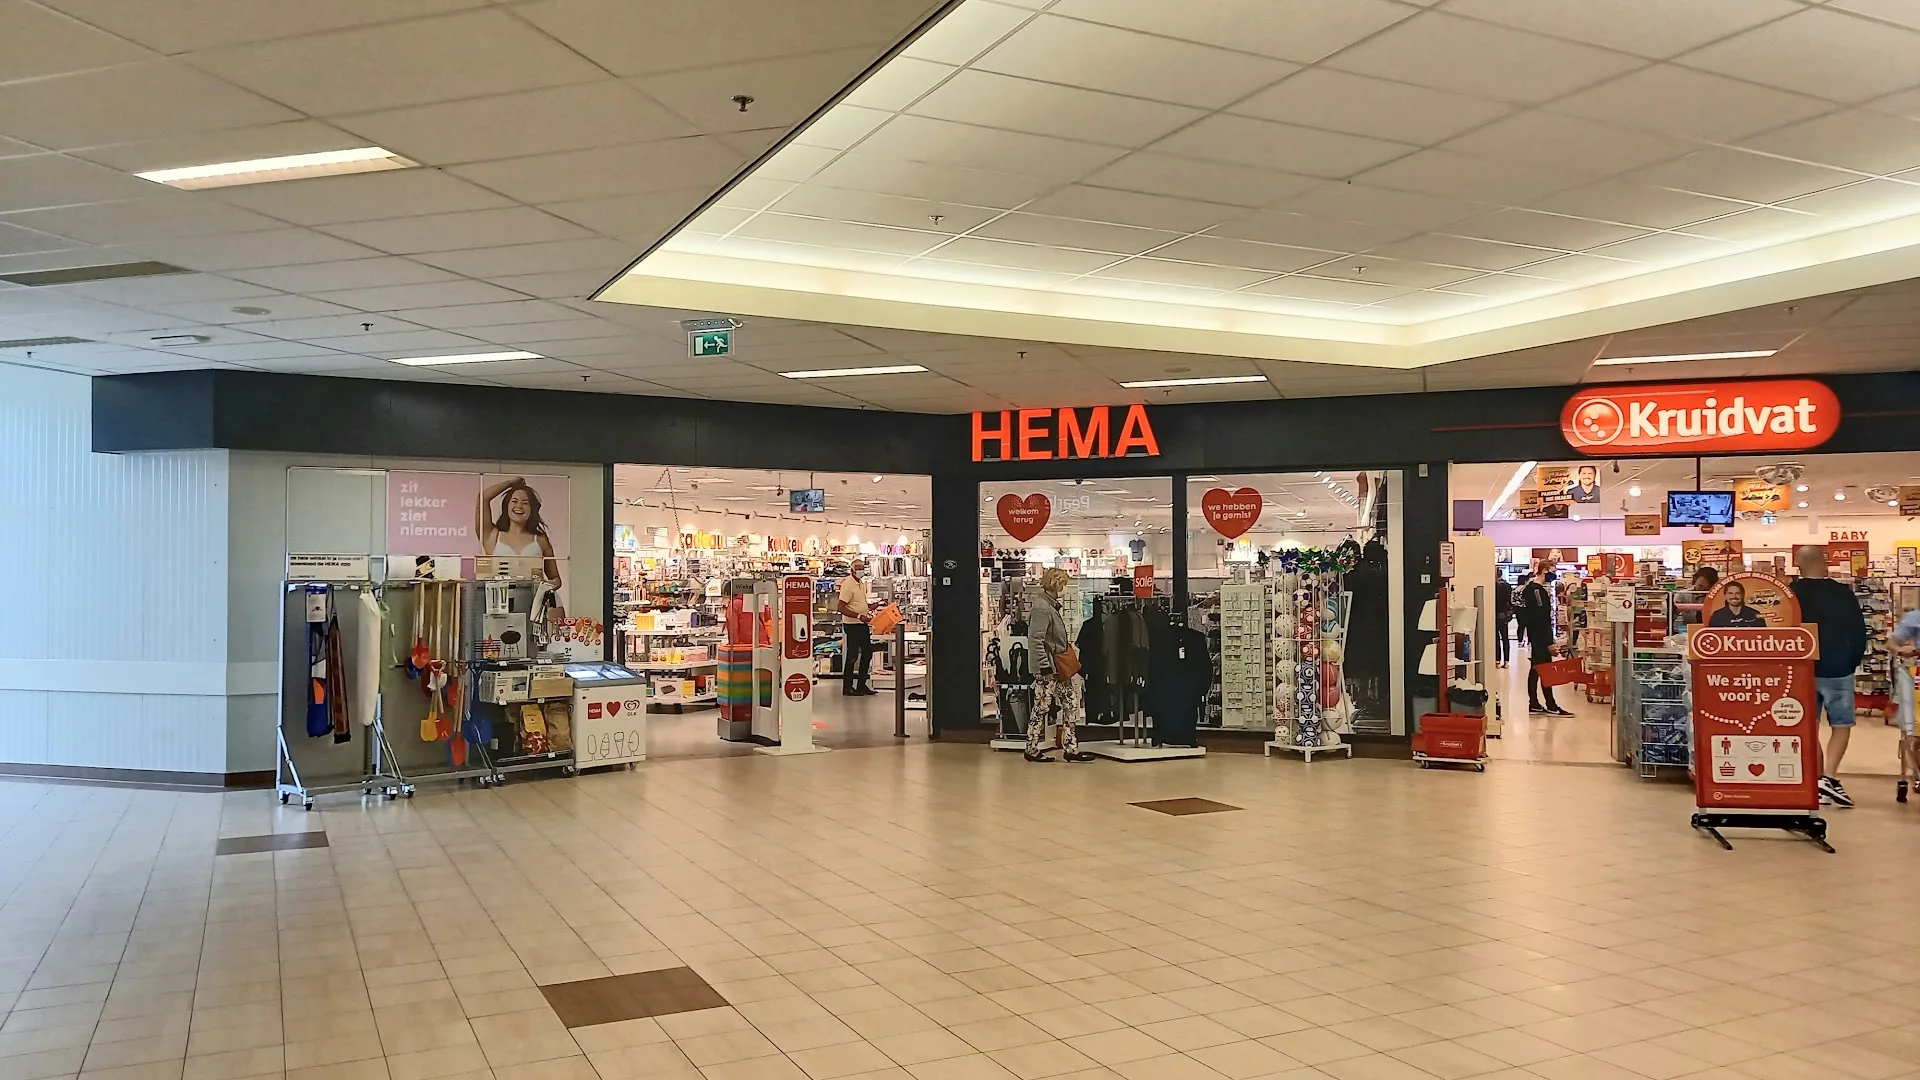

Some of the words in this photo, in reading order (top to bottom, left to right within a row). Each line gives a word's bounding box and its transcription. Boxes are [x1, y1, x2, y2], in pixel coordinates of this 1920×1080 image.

[1629, 396, 1817, 438] Kruidvat
[971, 404, 1160, 461] HEMA
[401, 481, 418, 493] zit
[400, 496, 447, 508] lekker
[400, 509, 427, 521] ziet
[1009, 507, 1039, 515] welkom
[1213, 511, 1221, 520] je
[1222, 511, 1251, 520] gemist
[400, 524, 467, 536] niemand
[1830, 531, 1868, 540] BABY
[768, 536, 802, 552] keuken
[1135, 575, 1153, 587] sale
[1723, 634, 1805, 652] Kruidvat
[1707, 674, 1729, 686] We
[1733, 673, 1761, 689] zijn
[1765, 677, 1781, 686] er
[1719, 692, 1752, 701] voor
[1754, 688, 1770, 704] je
